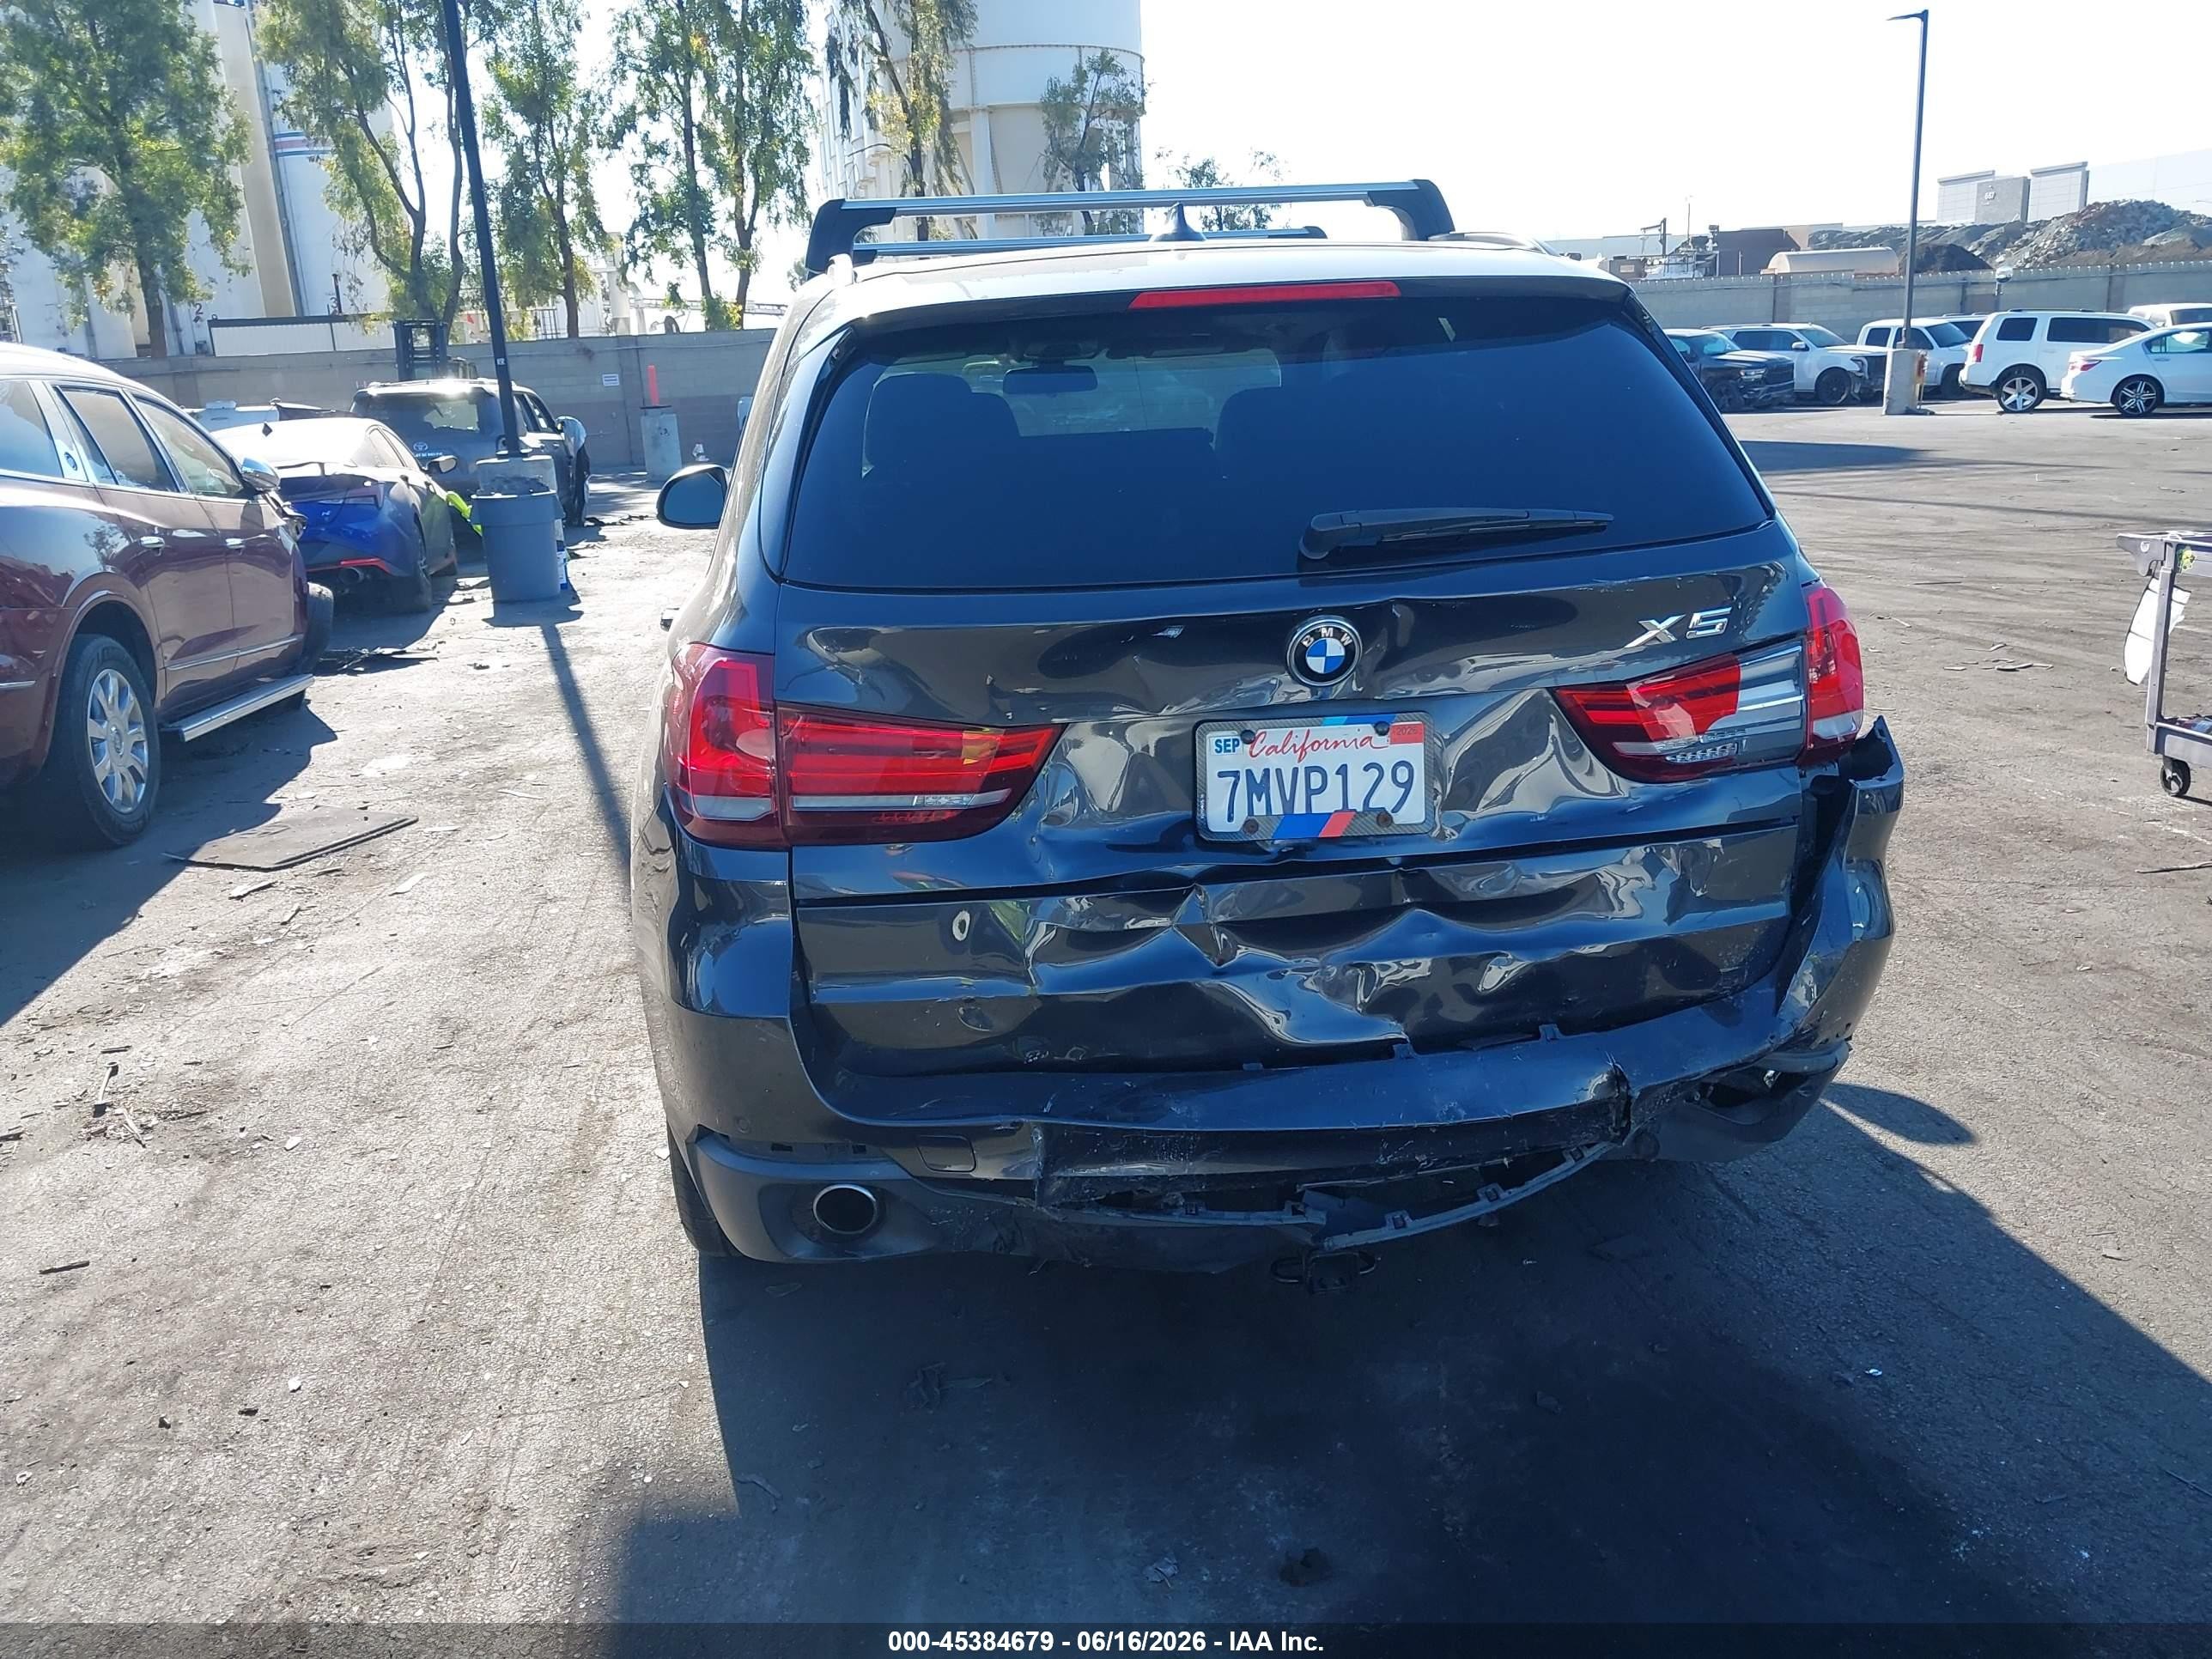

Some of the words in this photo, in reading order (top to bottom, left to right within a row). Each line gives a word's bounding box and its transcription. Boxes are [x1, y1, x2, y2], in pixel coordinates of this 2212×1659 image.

[1300, 626, 1353, 647] BMW
[1623, 606, 1733, 648] X5
[1214, 737, 1241, 754] SEP
[1249, 728, 1389, 763] California
[1216, 759, 1415, 823] 7MVP129
